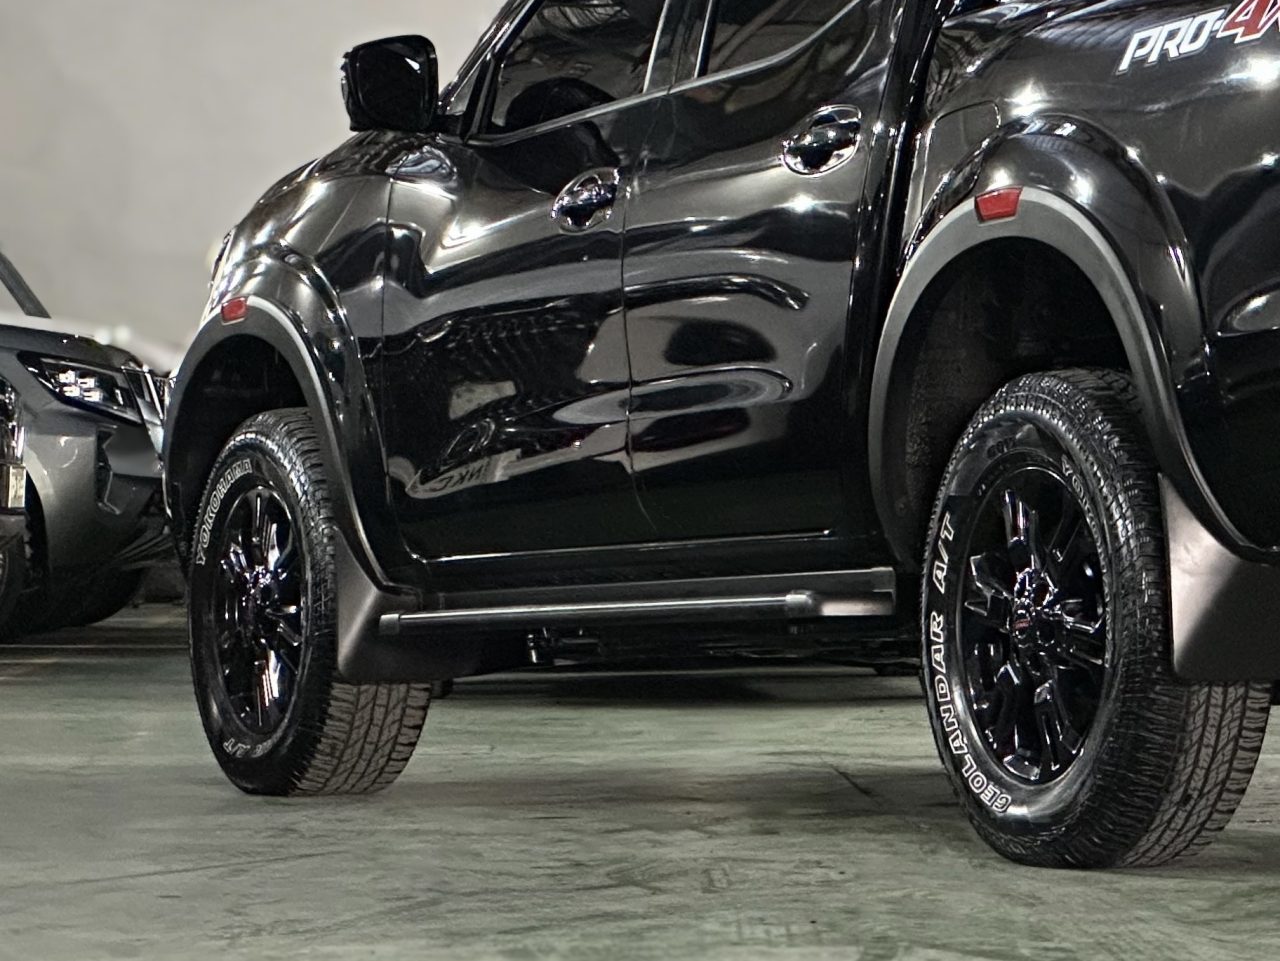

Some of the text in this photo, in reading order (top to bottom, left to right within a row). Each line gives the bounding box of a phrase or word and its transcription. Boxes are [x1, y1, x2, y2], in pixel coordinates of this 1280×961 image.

[196, 459, 253, 565] YOKOHAMA
[928, 512, 1012, 814] GEOLANDAR A/T
